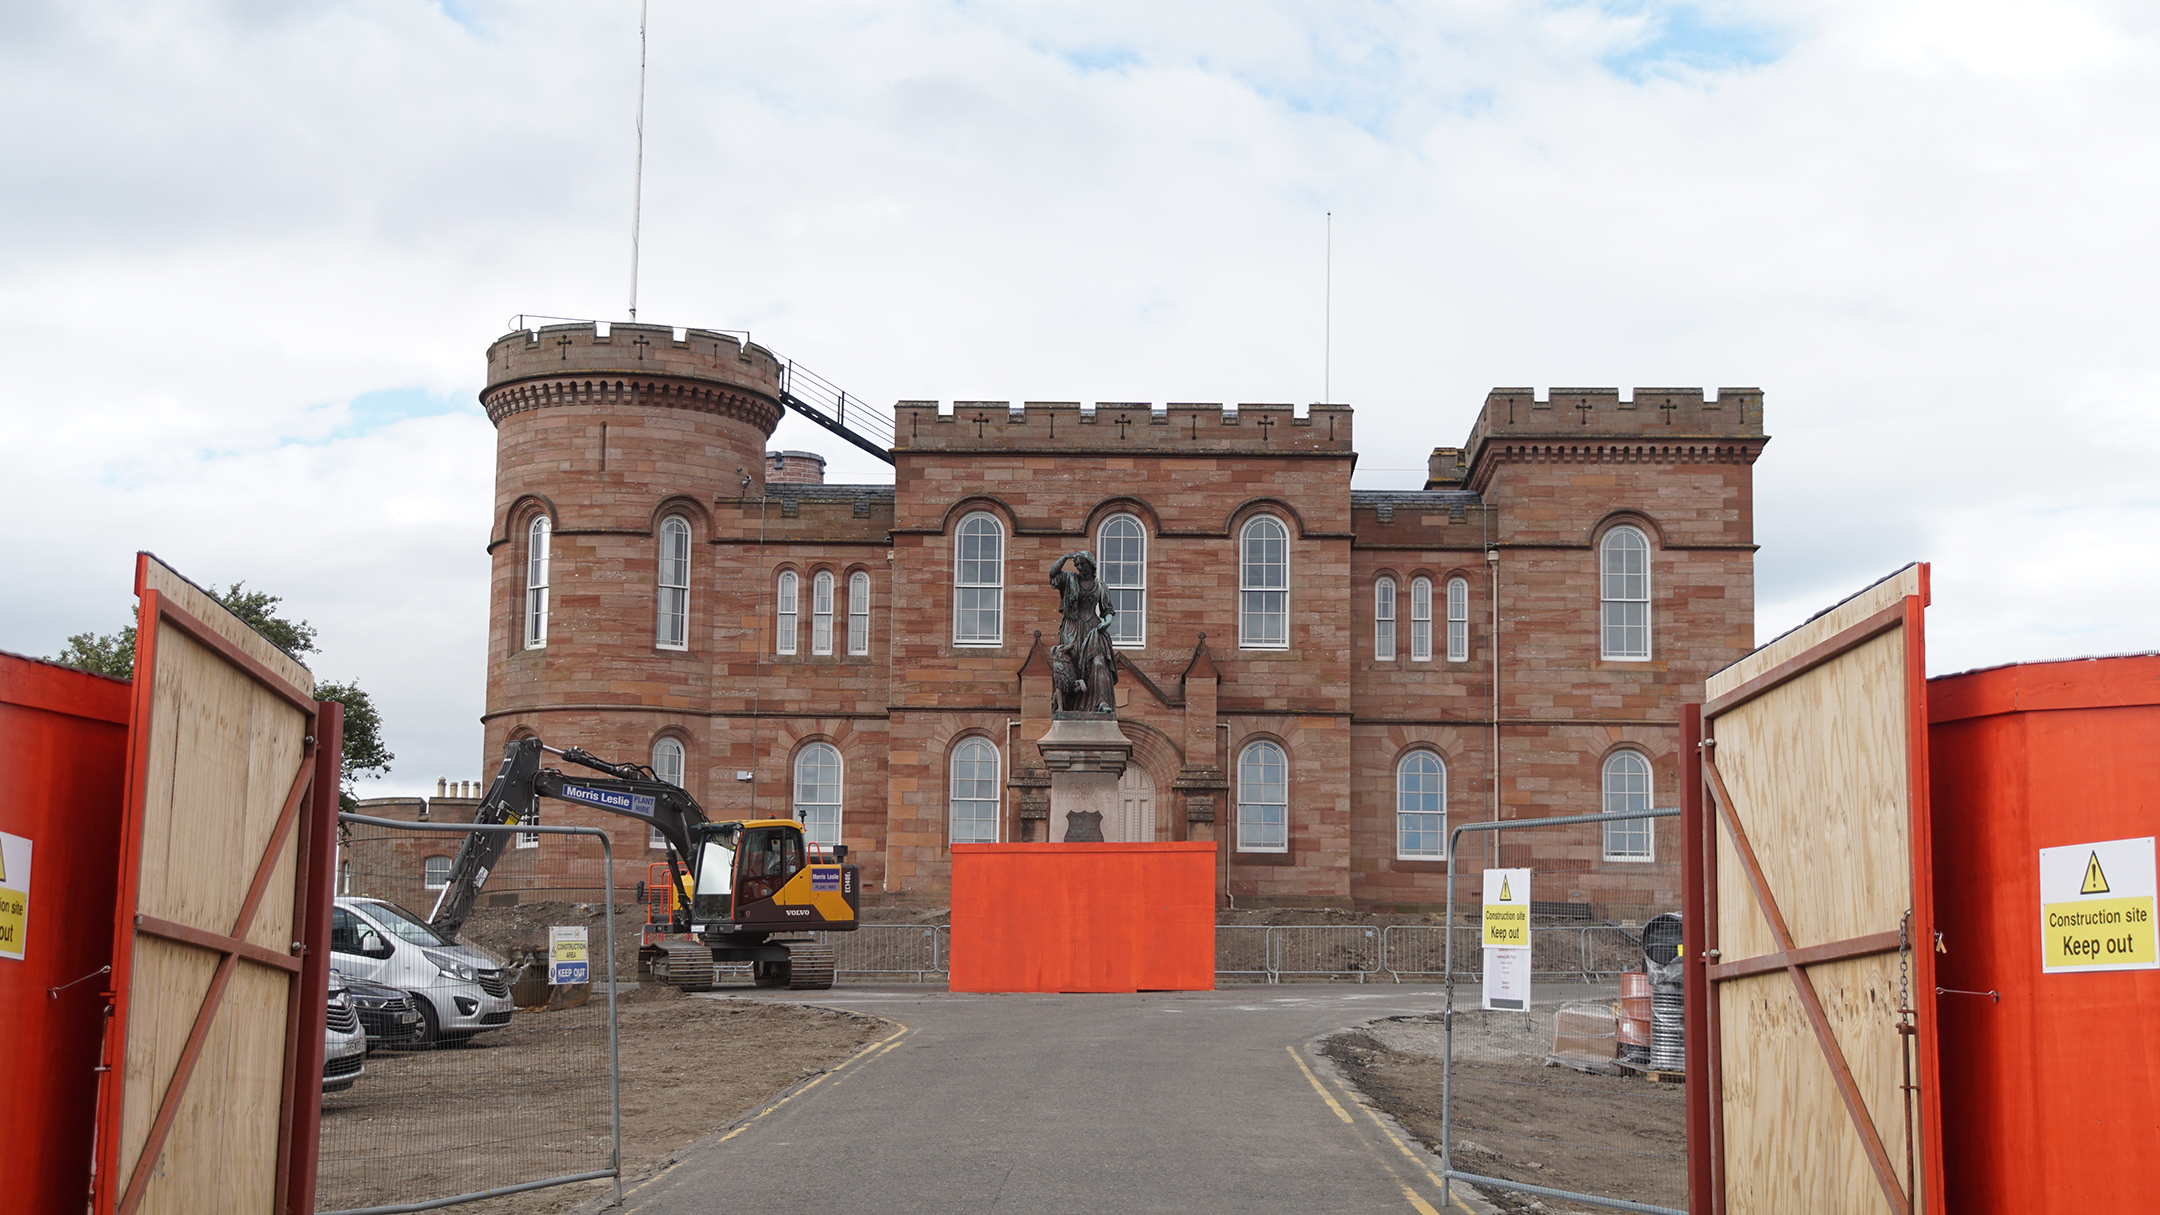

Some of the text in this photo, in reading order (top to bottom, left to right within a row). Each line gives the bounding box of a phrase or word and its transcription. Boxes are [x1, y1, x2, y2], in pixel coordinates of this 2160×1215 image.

[566, 786, 630, 807] Morris Leslie
[633, 795, 654, 806] PLANT
[635, 805, 650, 814] HIRE
[11, 901, 23, 916] site
[1485, 910, 1526, 921] Construction site
[2049, 907, 2148, 928] Construction site
[0, 924, 13, 942] out
[1490, 925, 1520, 942] Keep out
[2063, 934, 2134, 960] Keep out
[557, 967, 586, 978] KEEP OUT
